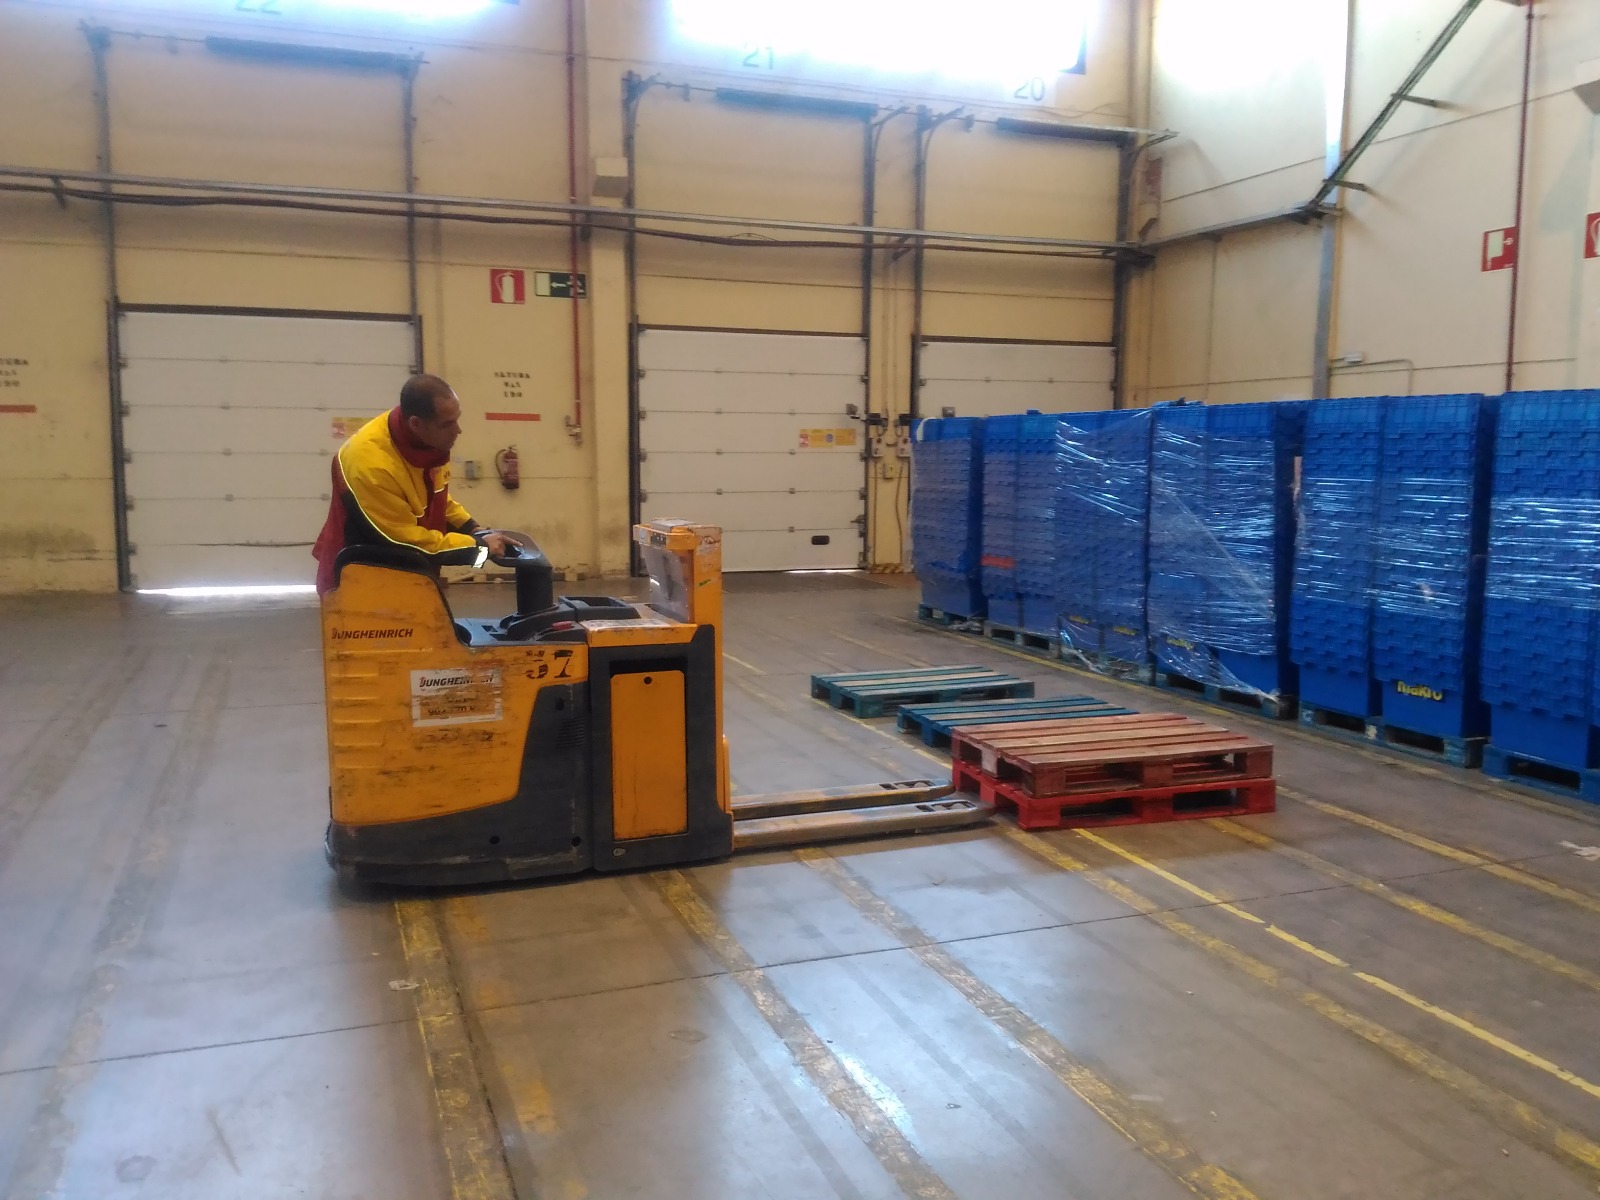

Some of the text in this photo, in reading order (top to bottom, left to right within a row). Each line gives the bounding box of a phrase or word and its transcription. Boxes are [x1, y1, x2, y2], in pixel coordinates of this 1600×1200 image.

[742, 39, 774, 70] 21
[1014, 75, 1046, 102] 20
[331, 626, 414, 640] JUNGHEINRICH
